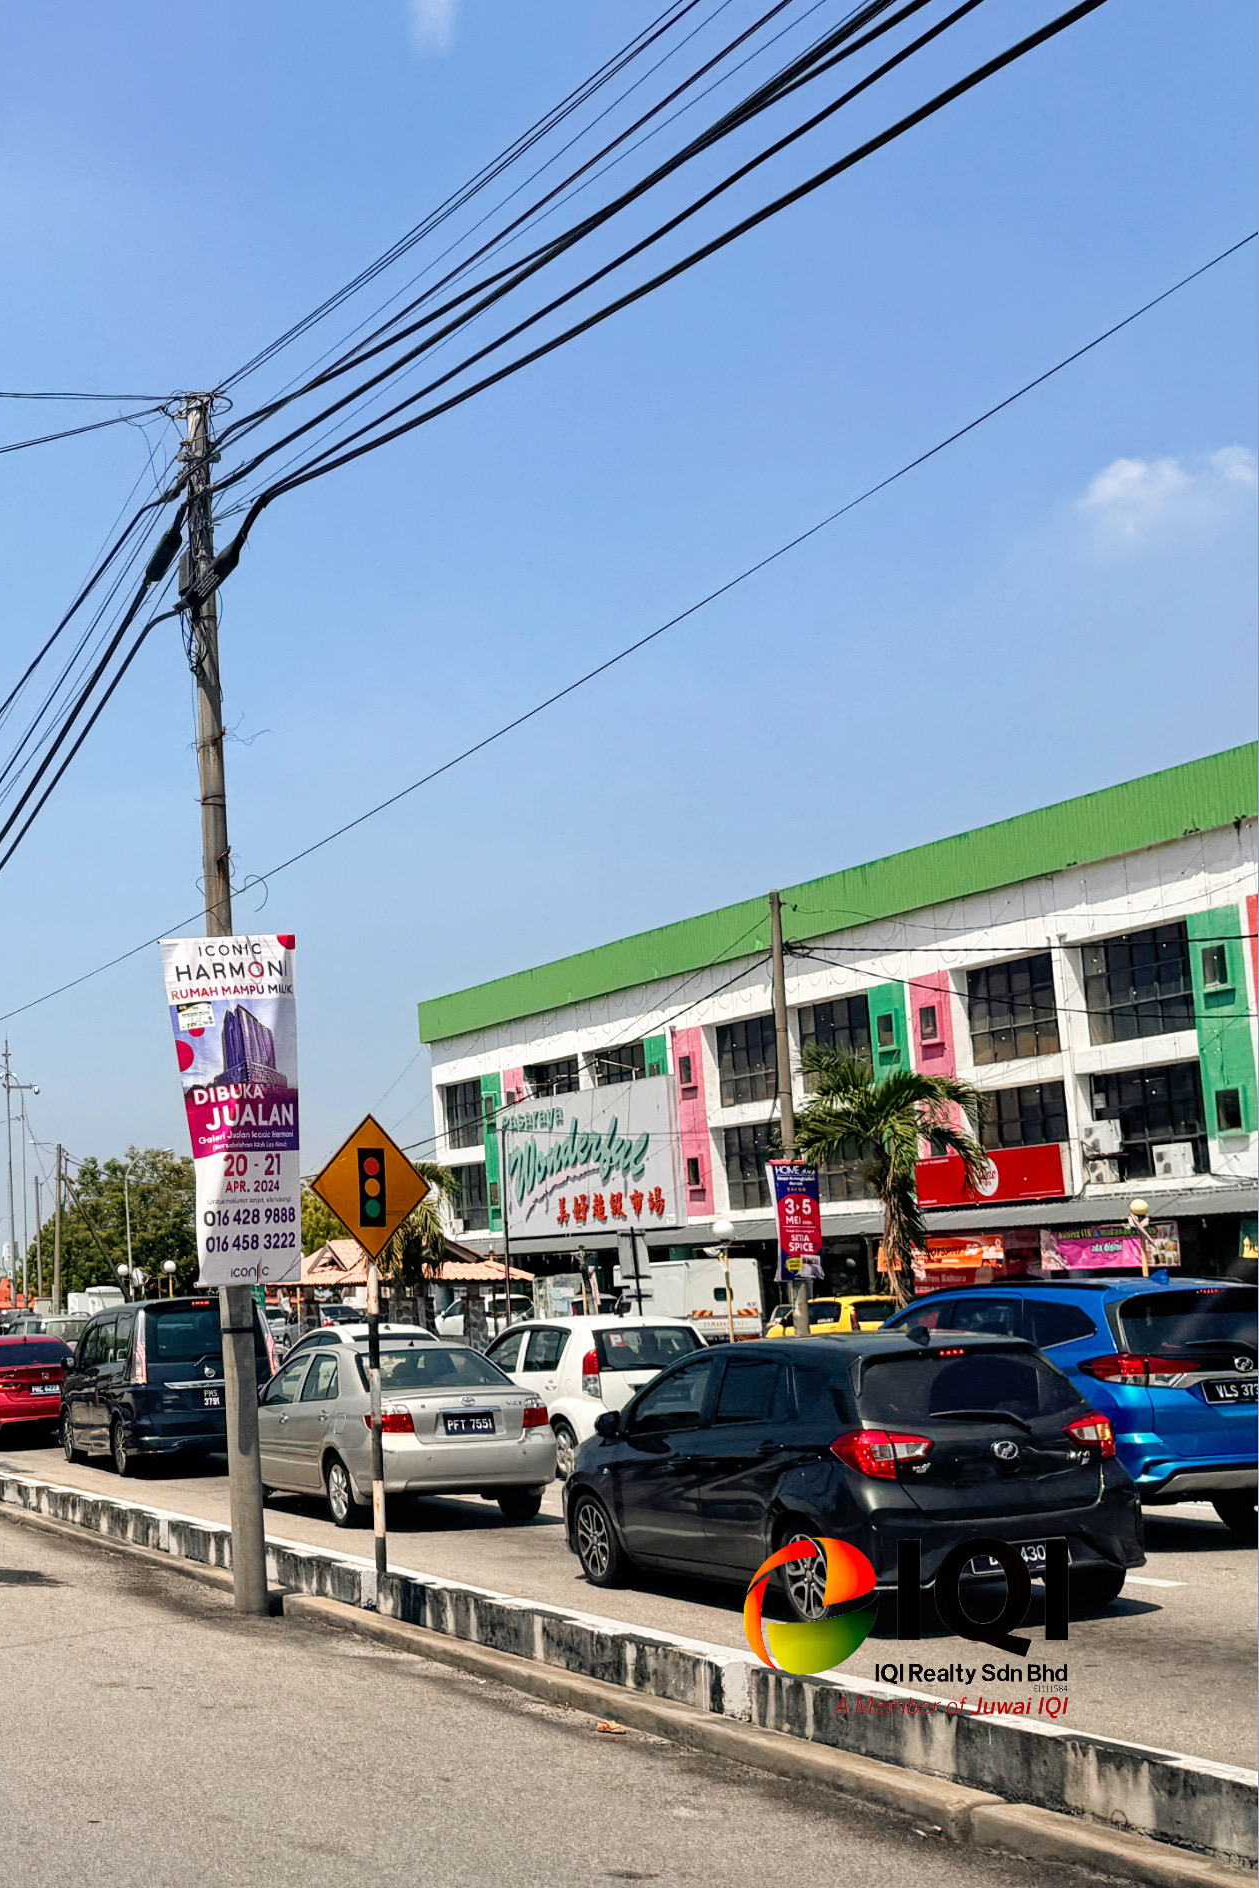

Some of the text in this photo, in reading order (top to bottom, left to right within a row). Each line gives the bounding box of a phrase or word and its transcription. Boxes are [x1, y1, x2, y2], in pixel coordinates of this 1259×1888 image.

[198, 943, 262, 957] ICONIC
[175, 960, 288, 982] HARMONI
[171, 984, 294, 1001] RUMAH MAMPU MILIK
[193, 1083, 265, 1106] DIBUKA
[205, 1103, 294, 1131] JUALAN
[502, 1106, 564, 1132] Pasaraya
[198, 1132, 226, 1145] Galeri
[223, 1153, 248, 1177] 20
[264, 1153, 281, 1176] 21
[510, 1115, 650, 1201] Wonderful
[775, 1165, 800, 1175] HOME
[225, 1180, 280, 1193] APR. 2024
[785, 1198, 812, 1215] 3 5
[203, 1206, 296, 1227] 016 428 9888
[786, 1216, 801, 1224] MEI
[206, 1231, 296, 1253] 016 458 3222
[789, 1242, 814, 1252] SPICE
[203, 1389, 218, 1398] PMS
[1215, 1384, 1239, 1398] VLS
[203, 1397, 220, 1405] 3791
[447, 1418, 493, 1431] PFT 7551
[1021, 1544, 1046, 1562] 430
